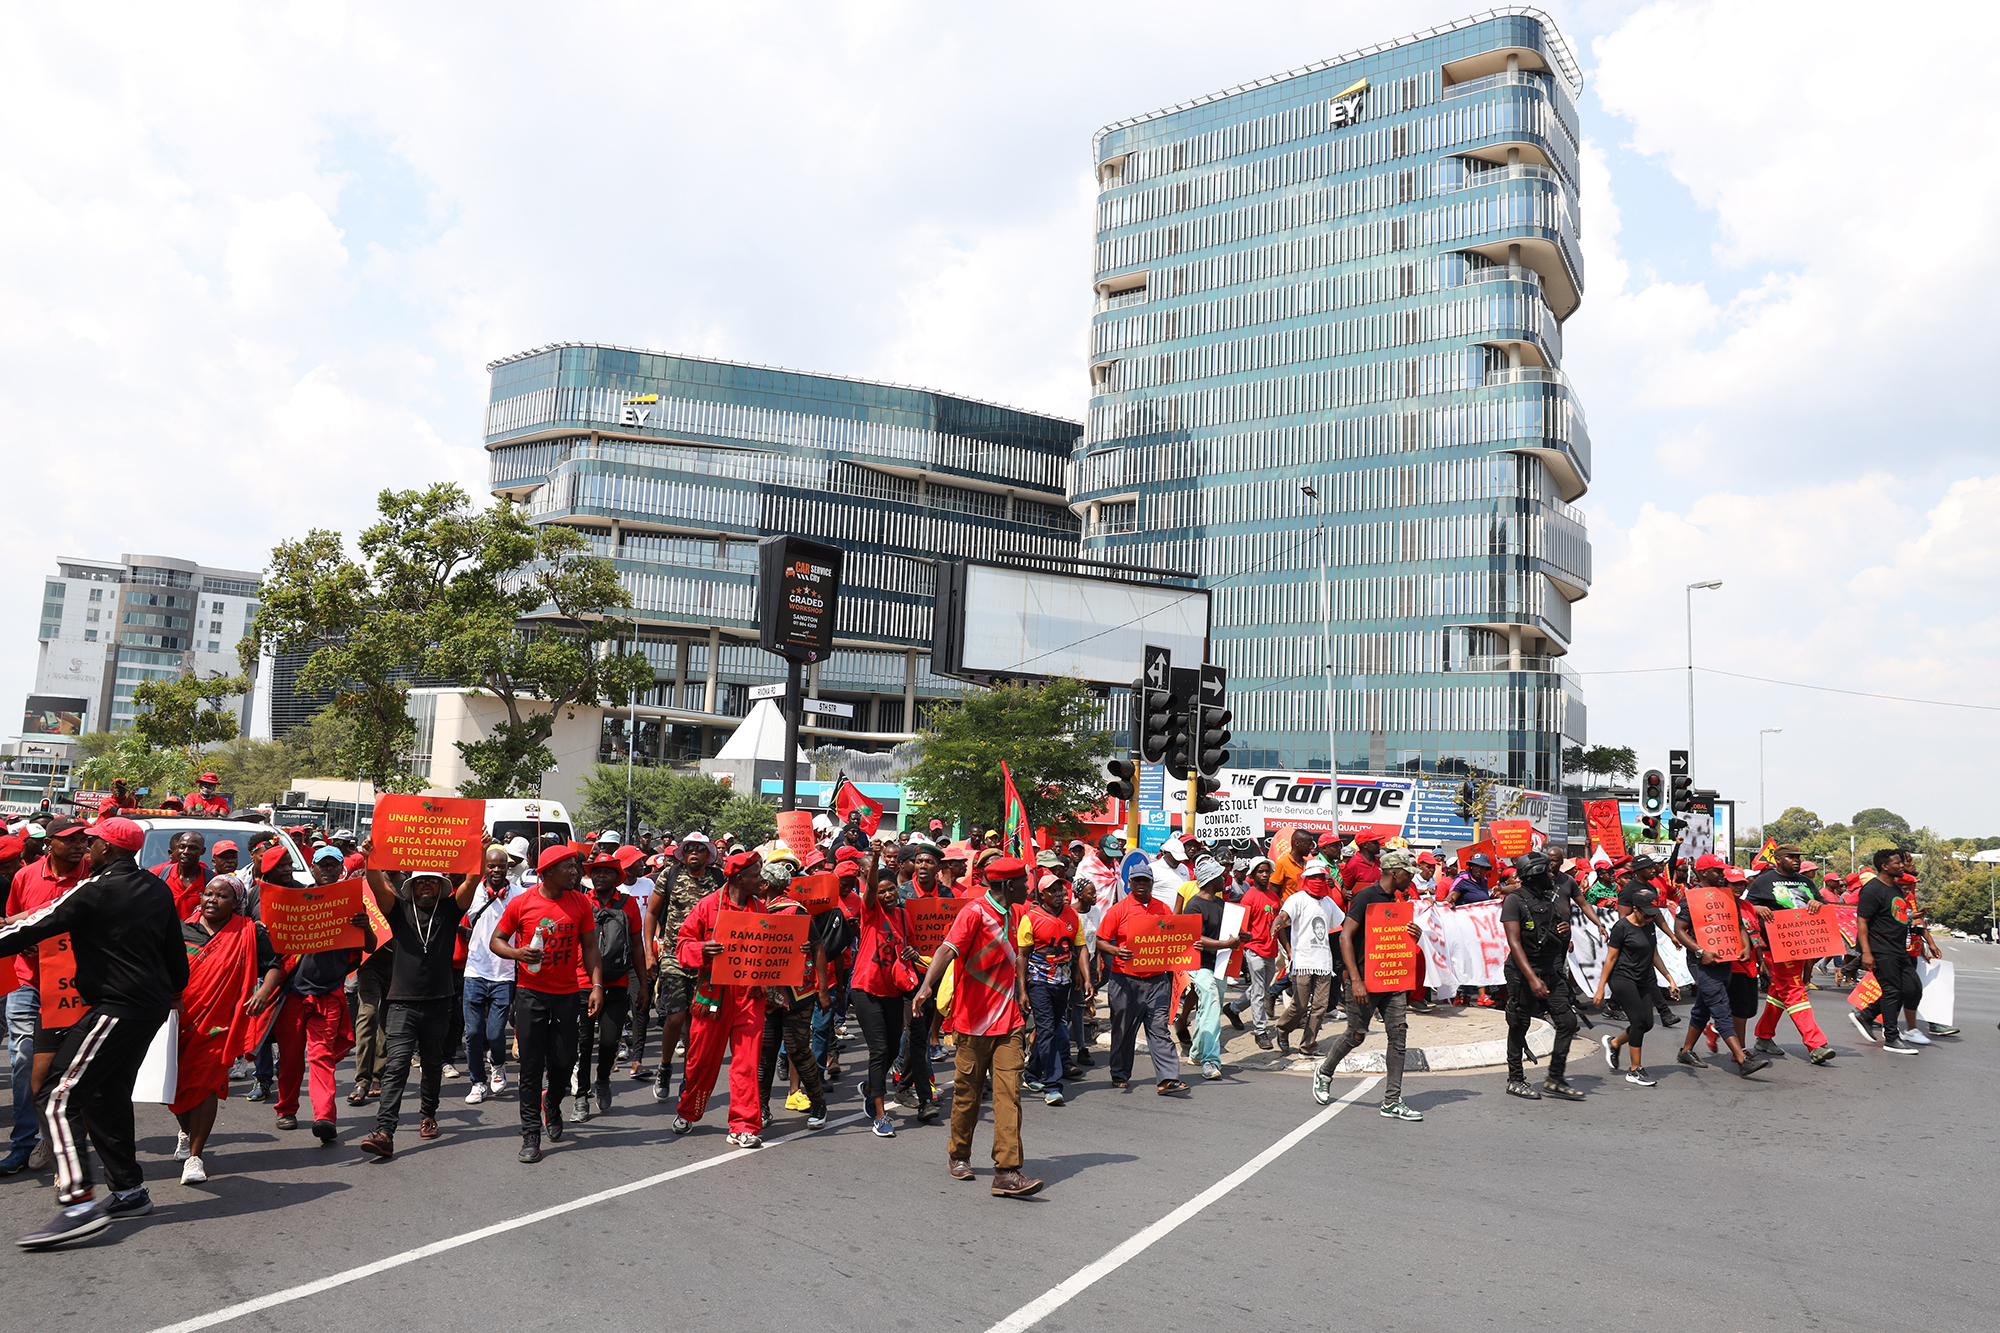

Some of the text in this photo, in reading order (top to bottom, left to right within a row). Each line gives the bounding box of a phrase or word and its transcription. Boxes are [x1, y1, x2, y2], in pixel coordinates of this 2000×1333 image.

[1330, 97, 1361, 123] EY
[620, 406, 651, 426] EY
[795, 561, 832, 577] CAR SERVICE
[789, 594, 824, 608] GRADED
[788, 602, 824, 614] WORKSHOP
[792, 613, 818, 623] SANDTON
[1231, 774, 1256, 786] THE
[1253, 776, 1403, 814] Garage
[1150, 812, 1164, 820] PG
[1264, 805, 1343, 816] hicle Service Cene
[388, 813, 470, 825] UNEMPLOYMENT
[1204, 813, 1242, 825] CONTACT:
[404, 825, 452, 836] IN SOUTH
[1196, 825, 1251, 838] 082 853 2265
[386, 836, 467, 847] AFRICA CANNOT
[392, 847, 459, 857] BE TOLERATED
[399, 858, 450, 868] ANYMORE
[271, 897, 350, 913] UNEMPLOYMENT
[1706, 902, 1725, 910] GBV
[286, 910, 333, 922] IN SOUTH
[362, 894, 390, 930] OSPITALS
[917, 913, 956, 921] RAMAPH
[1704, 914, 1713, 922] IS
[271, 916, 348, 932] AFRICA CANNOT
[558, 922, 575, 932] EFF
[925, 923, 946, 931] NOT
[1384, 925, 1408, 933] CANNOT
[1705, 924, 1735, 934] ORDER
[1776, 919, 1827, 930] RAMAPHOSA
[277, 927, 342, 941] BE TOLERATED
[730, 930, 794, 942] RAMAPHOSA
[1134, 933, 1194, 943] RAMAPHOSA
[1788, 930, 1804, 938] NOT
[1806, 927, 1829, 936] LOYAL
[284, 938, 334, 950] ANYMORE
[1708, 935, 1739, 946] OF THE
[1781, 936, 1830, 948] TO HIS OATH
[727, 943, 793, 955] IS NOT LOYAL
[920, 944, 933, 952] OF
[1139, 945, 1187, 955] MUST STEP
[1375, 943, 1407, 951] PRESIDENT
[1718, 947, 1737, 956] DAY
[1789, 946, 1827, 957] OF OFFICE
[542, 949, 572, 966] EFF
[1386, 951, 1413, 959] PRESIDES
[728, 956, 789, 967] TO HIS OATH
[1132, 956, 1192, 967] DOWN NOW
[733, 970, 781, 979] OF OFFICE
[1374, 969, 1408, 977] COLLAPSED
[1861, 981, 1874, 991] THAT
[1858, 993, 1873, 1004] COLLA
[1865, 990, 1879, 1001] OVER
[58, 996, 84, 1010] AF
